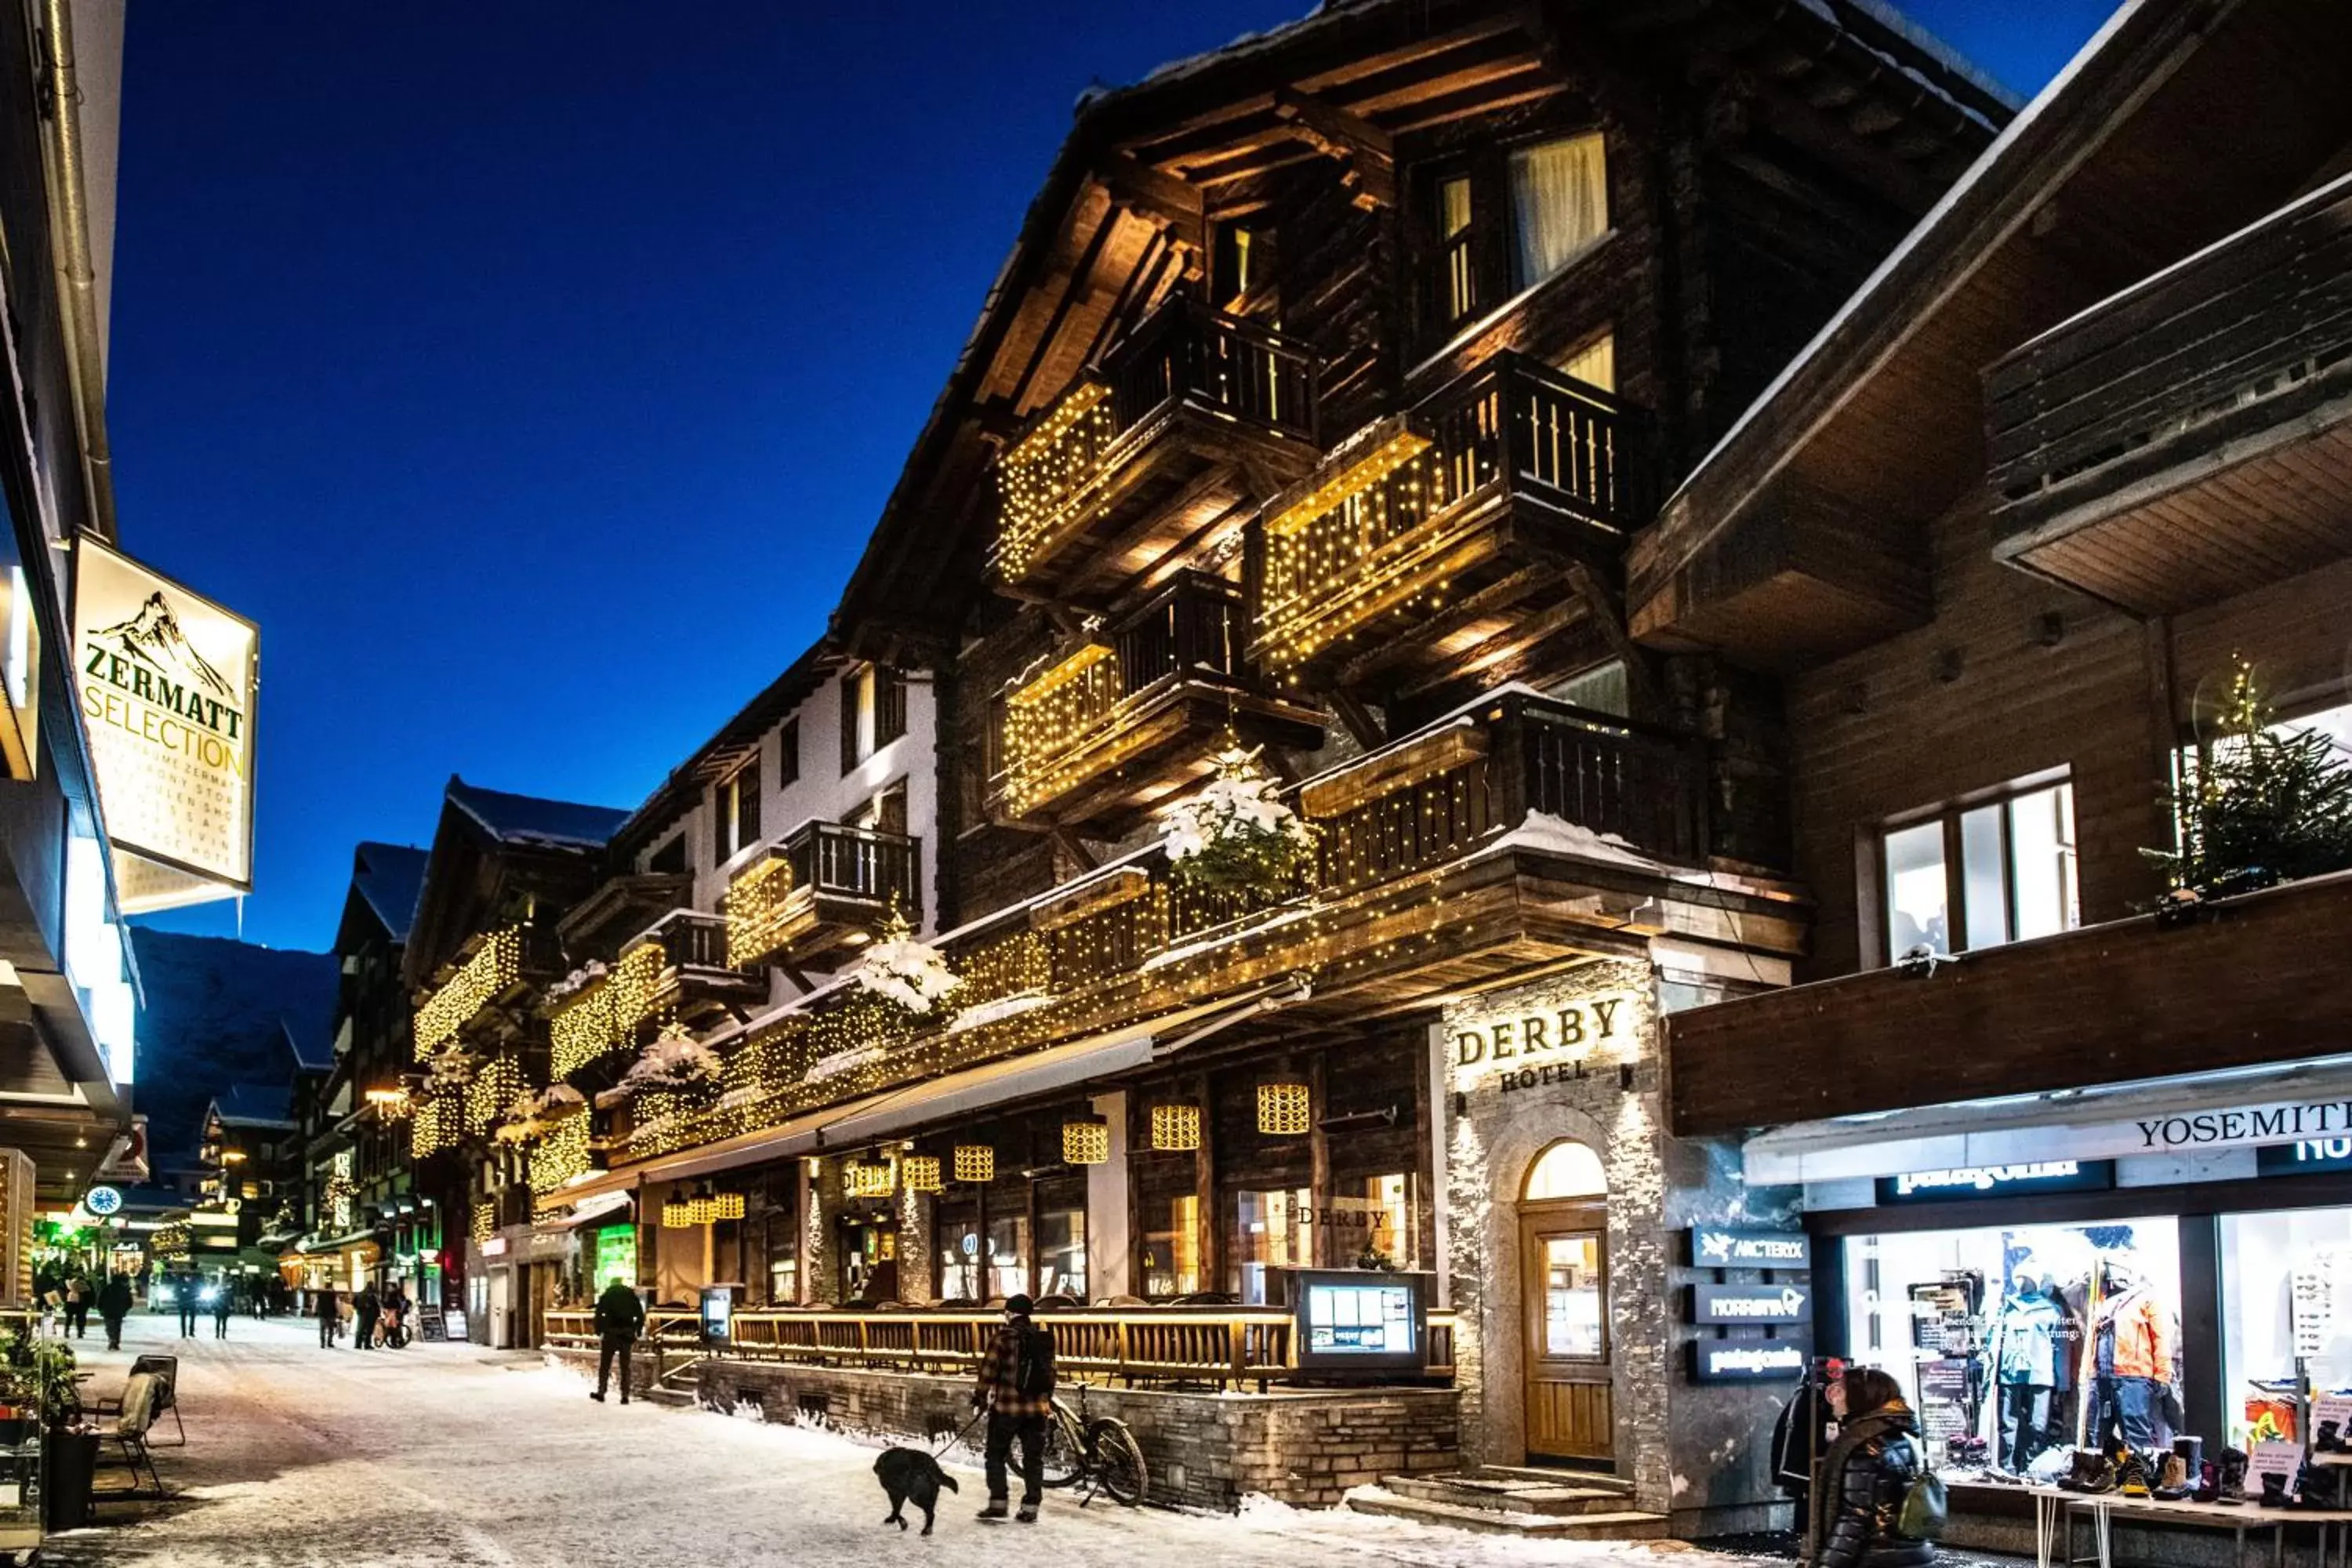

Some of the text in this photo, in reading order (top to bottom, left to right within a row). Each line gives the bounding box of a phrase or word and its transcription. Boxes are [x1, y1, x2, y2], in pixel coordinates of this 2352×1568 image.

[85, 642, 242, 739] ZERMATT
[85, 685, 244, 779] SELECTION
[1457, 998, 1624, 1067] DERBY
[1500, 1059, 1591, 1092] HOTEL
[1298, 1207, 1386, 1229] DERBY
